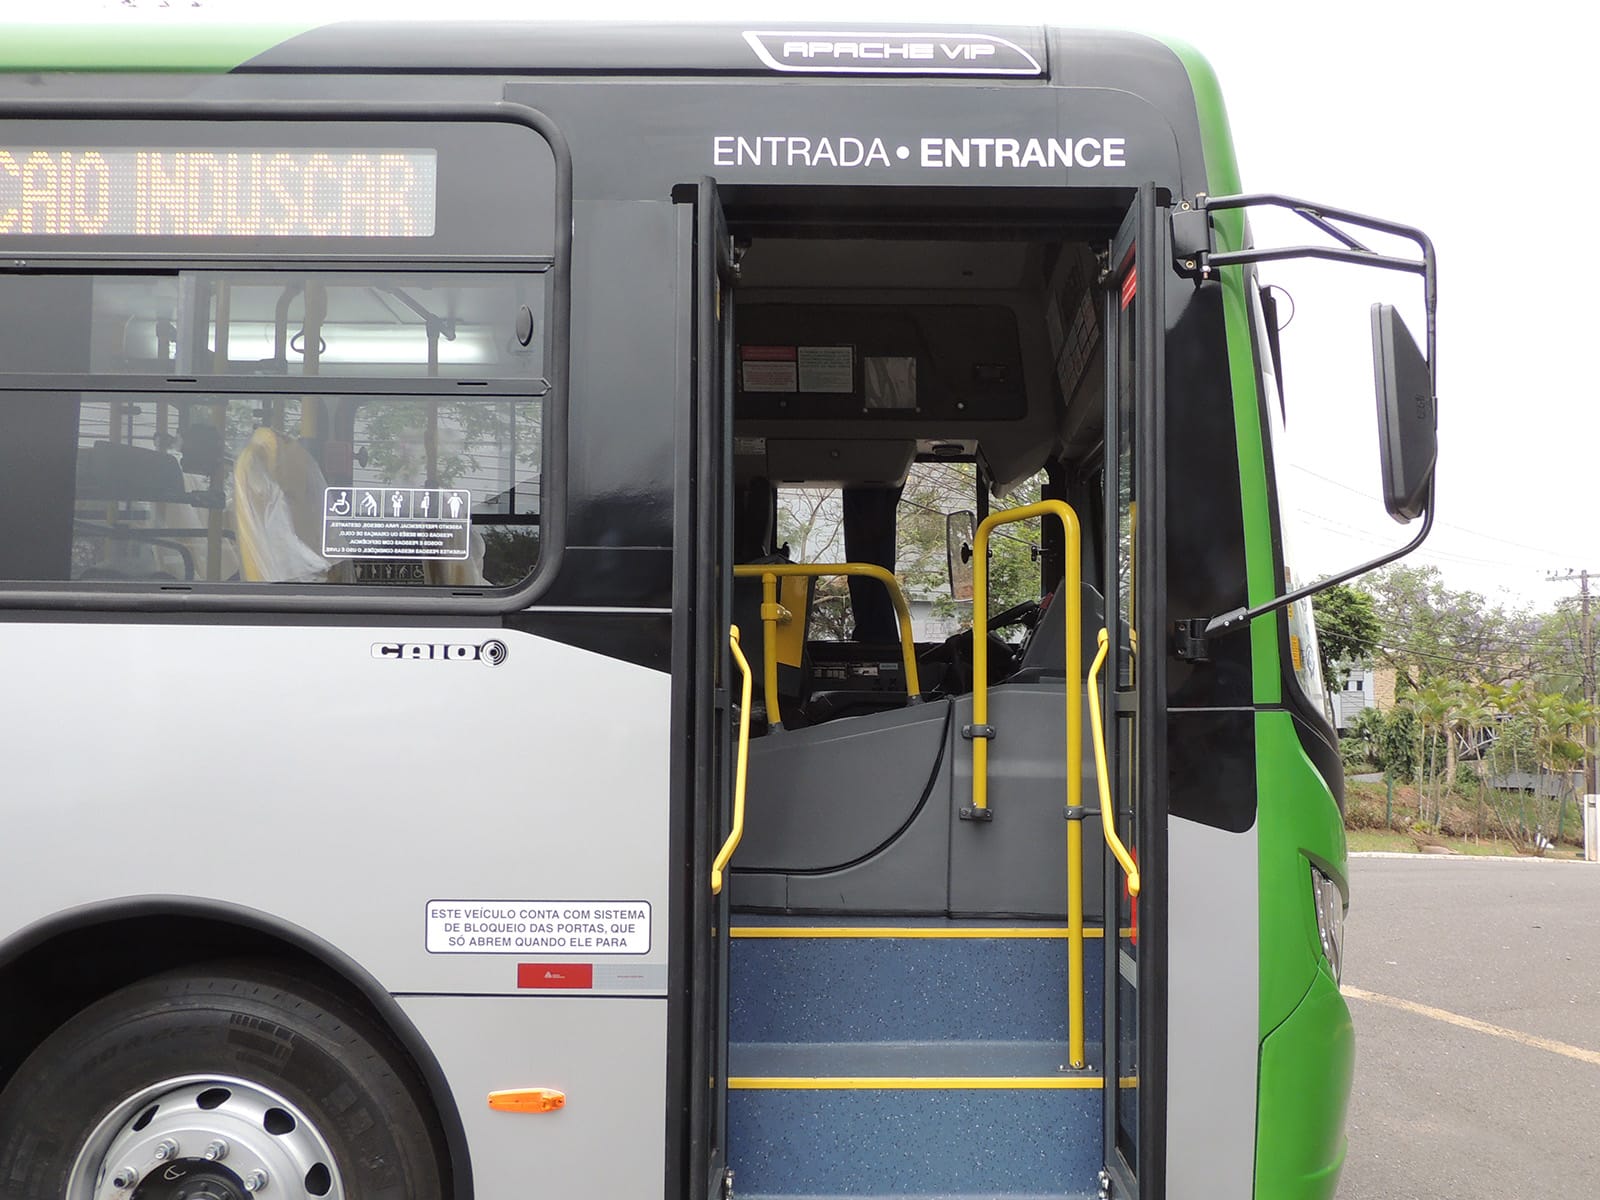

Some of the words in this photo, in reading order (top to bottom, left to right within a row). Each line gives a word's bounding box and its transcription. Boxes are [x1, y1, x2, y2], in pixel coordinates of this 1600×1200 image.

[783, 42, 934, 59] APACHE
[940, 43, 995, 60] VIP
[713, 136, 890, 167] ENTRADA
[920, 137, 1126, 168] ENTRANCE
[137, 153, 414, 236] INDUSCAR
[371, 642, 481, 660] CAIO
[431, 909, 461, 919] ESTE
[464, 907, 516, 919] VEÍCULO
[519, 910, 560, 920] CONTA
[563, 910, 591, 920] COM
[594, 909, 645, 920] SISTEMA
[444, 923, 460, 933] DE
[464, 923, 526, 933] BLOQUEIO
[529, 923, 554, 933] DAS
[557, 924, 608, 934] PORTAS,
[610, 924, 635, 934] QUE
[448, 935, 465, 947] SÓ
[469, 937, 512, 947] ABREM
[515, 937, 566, 947] QUANDO
[569, 937, 592, 947] ELE
[596, 938, 628, 947] PARA
